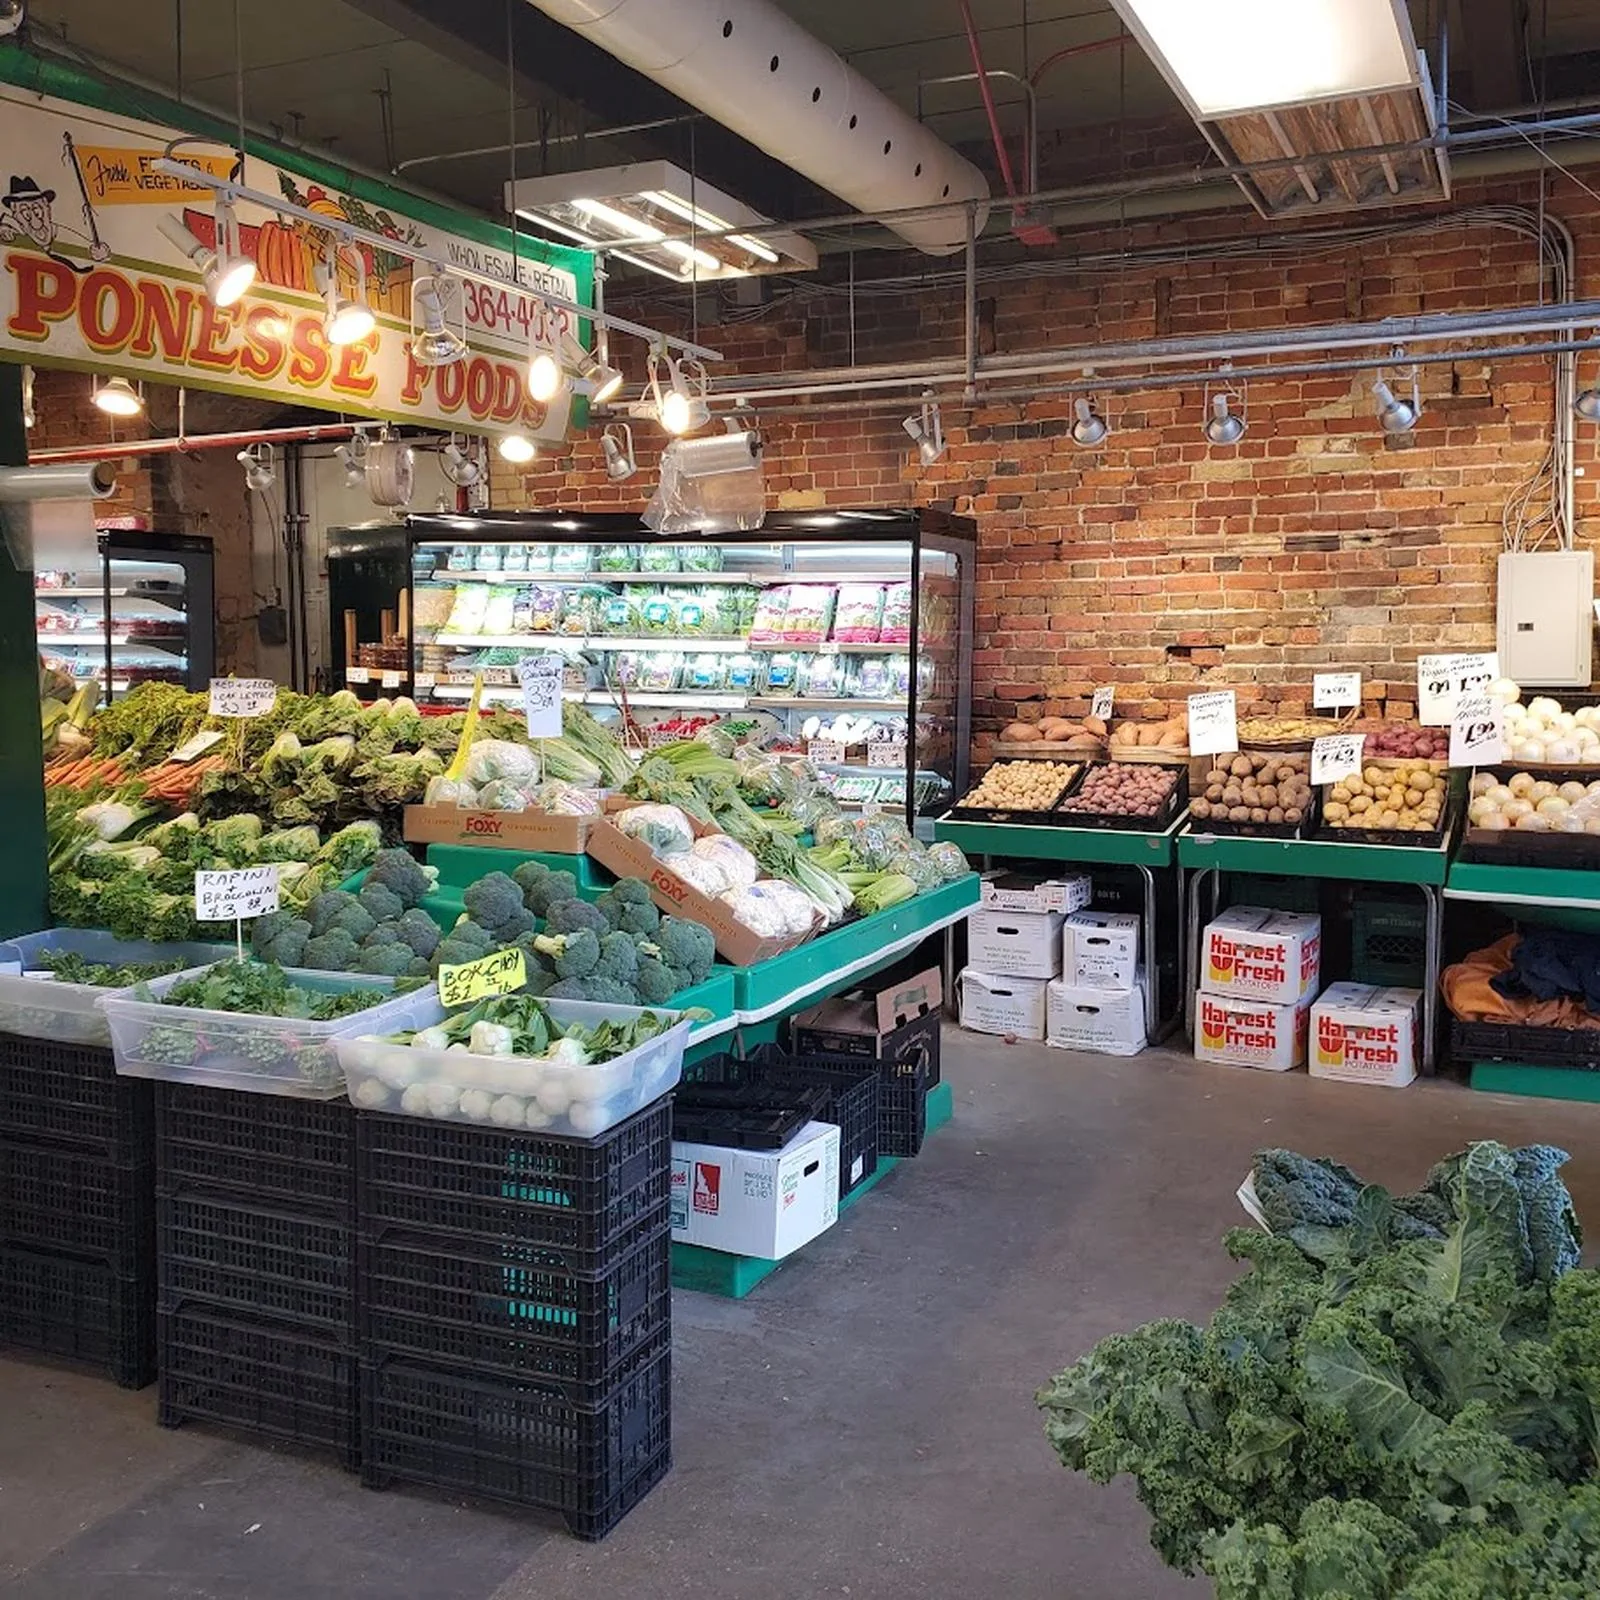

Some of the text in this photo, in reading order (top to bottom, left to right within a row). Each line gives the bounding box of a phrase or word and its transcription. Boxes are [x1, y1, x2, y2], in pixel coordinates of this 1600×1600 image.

[3, 252, 381, 398] PONESSE
[466, 816, 502, 834] FOXY
[203, 867, 271, 886] RAPINI
[650, 868, 689, 902] FOXY
[1211, 933, 1286, 963] Harvest
[443, 951, 519, 988] BOK CHOY
[1234, 958, 1285, 983] Fresh
[1234, 979, 1279, 991] POTATOES
[1202, 1001, 1276, 1029] Harvest
[1226, 1025, 1276, 1049] Fresh
[1318, 1015, 1398, 1043] Harvest
[1344, 1040, 1398, 1064] Fresh
[1344, 1061, 1393, 1072] POTATOES
